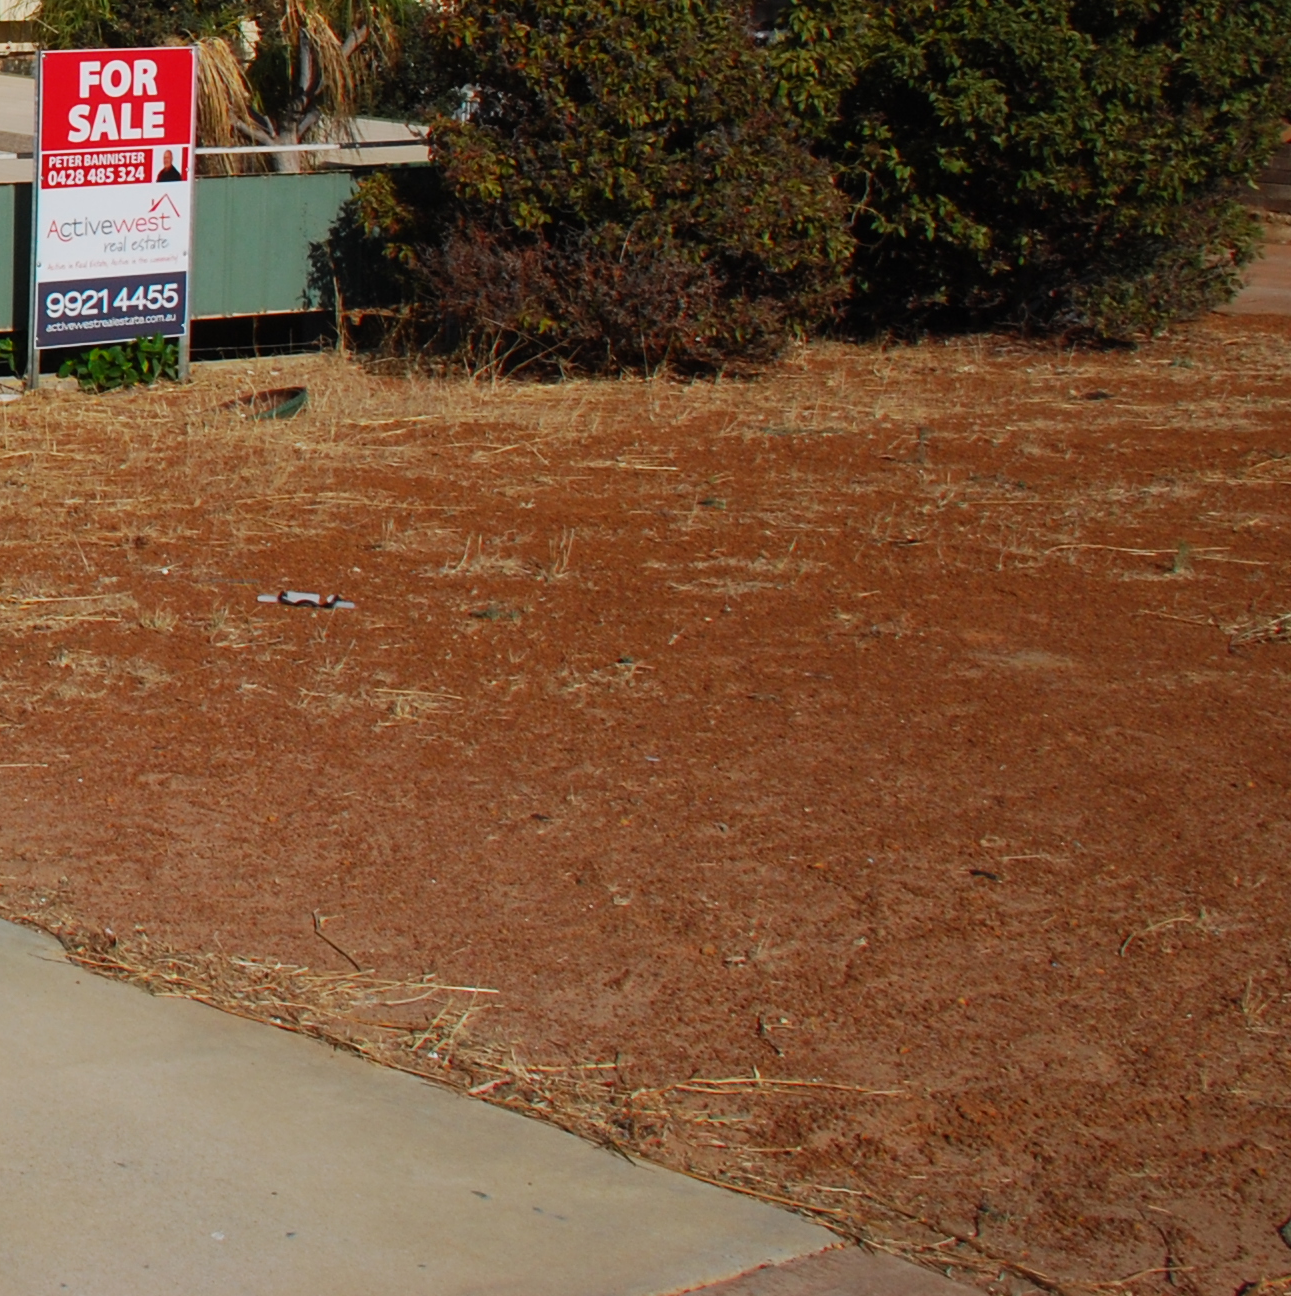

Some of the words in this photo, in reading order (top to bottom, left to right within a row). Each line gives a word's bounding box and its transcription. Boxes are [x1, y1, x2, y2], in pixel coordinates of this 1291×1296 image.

[79, 59, 158, 98] FOR
[67, 101, 165, 143] SALE
[48, 154, 82, 168] PETER
[84, 151, 145, 167] BANNISTER
[47, 168, 85, 186] 0428
[86, 167, 114, 184] 485
[117, 165, 145, 182] 324
[46, 212, 172, 242] Activewest
[103, 236, 127, 253] real
[131, 234, 169, 251] estate
[45, 288, 109, 318] 9921
[113, 283, 179, 312] 4455
[45, 313, 177, 333] activewestrealestate.com.au
